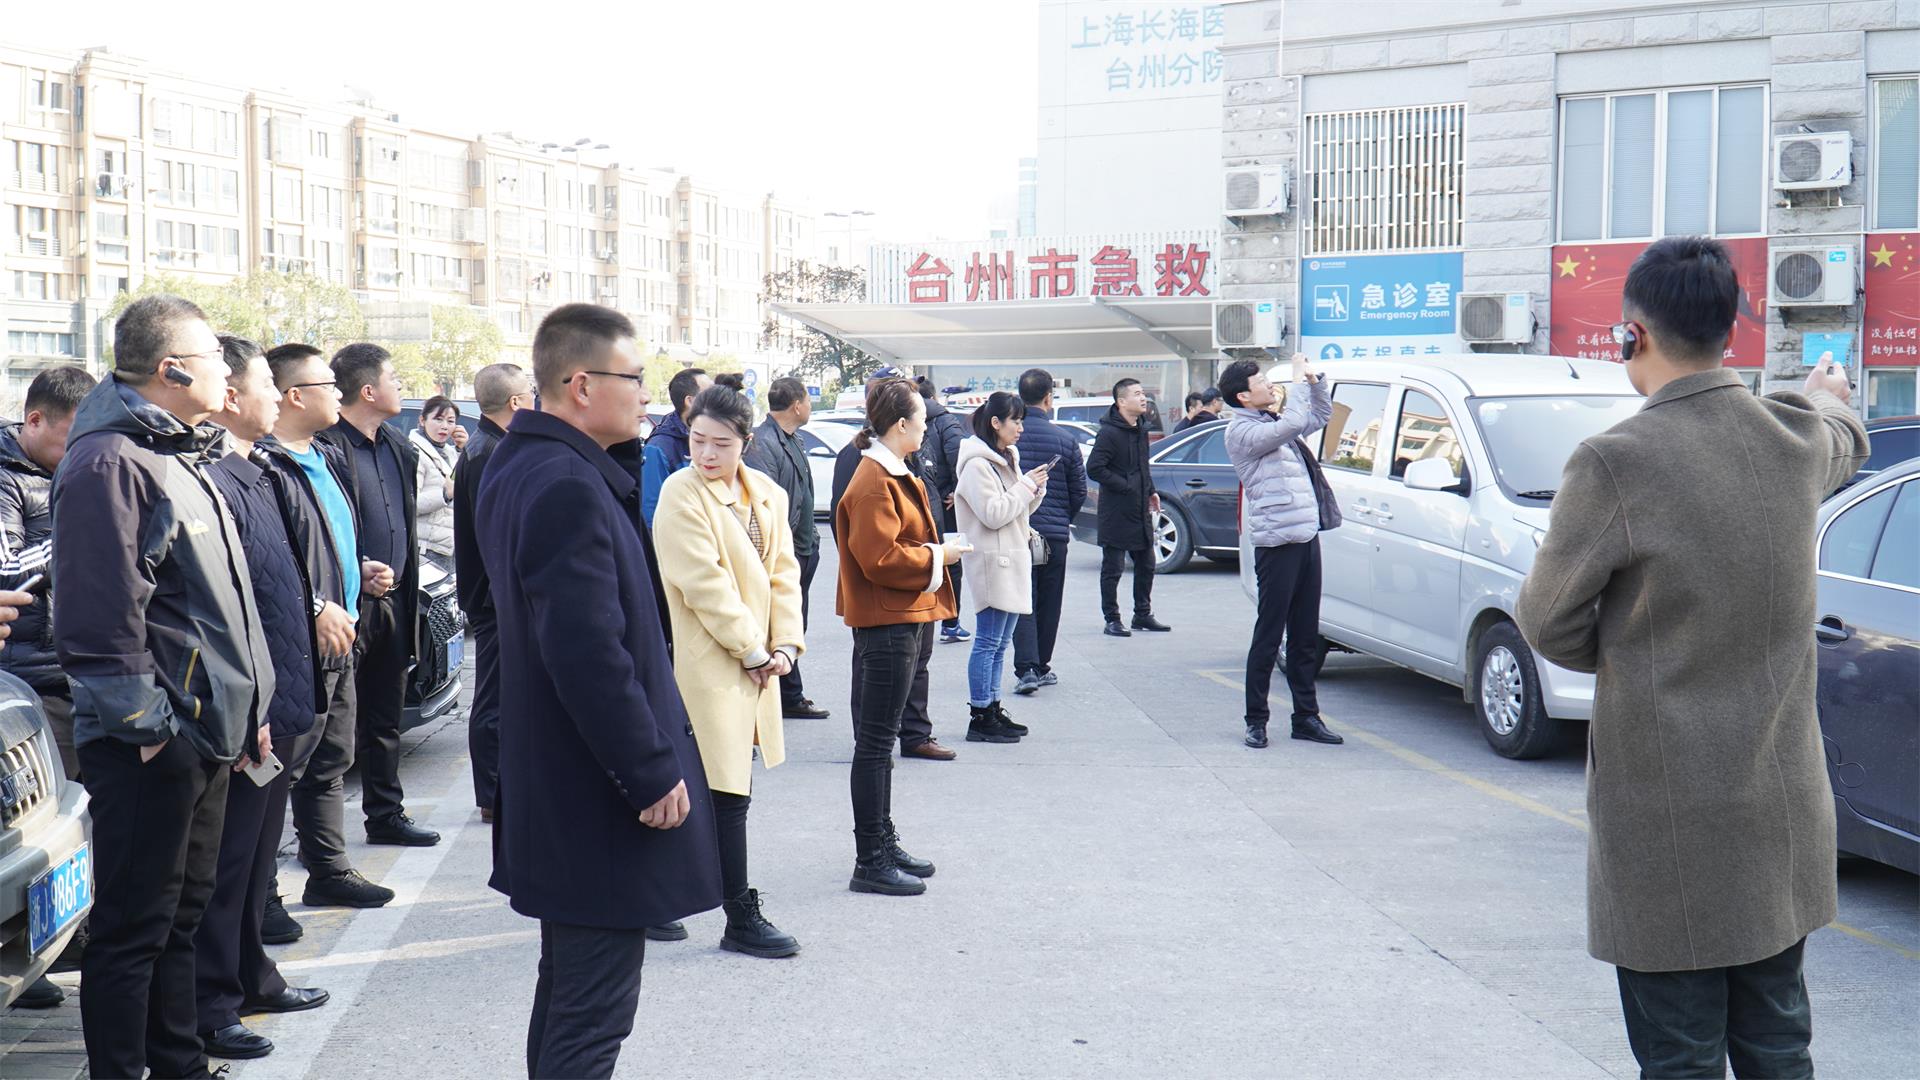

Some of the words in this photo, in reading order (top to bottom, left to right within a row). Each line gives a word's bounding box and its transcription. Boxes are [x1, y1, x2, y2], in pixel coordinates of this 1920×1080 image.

[906, 243, 1210, 303] 台州市急救
[1361, 281, 1451, 309] 急诊室
[1360, 310, 1418, 321] Emergency
[1420, 309, 1450, 319] Room
